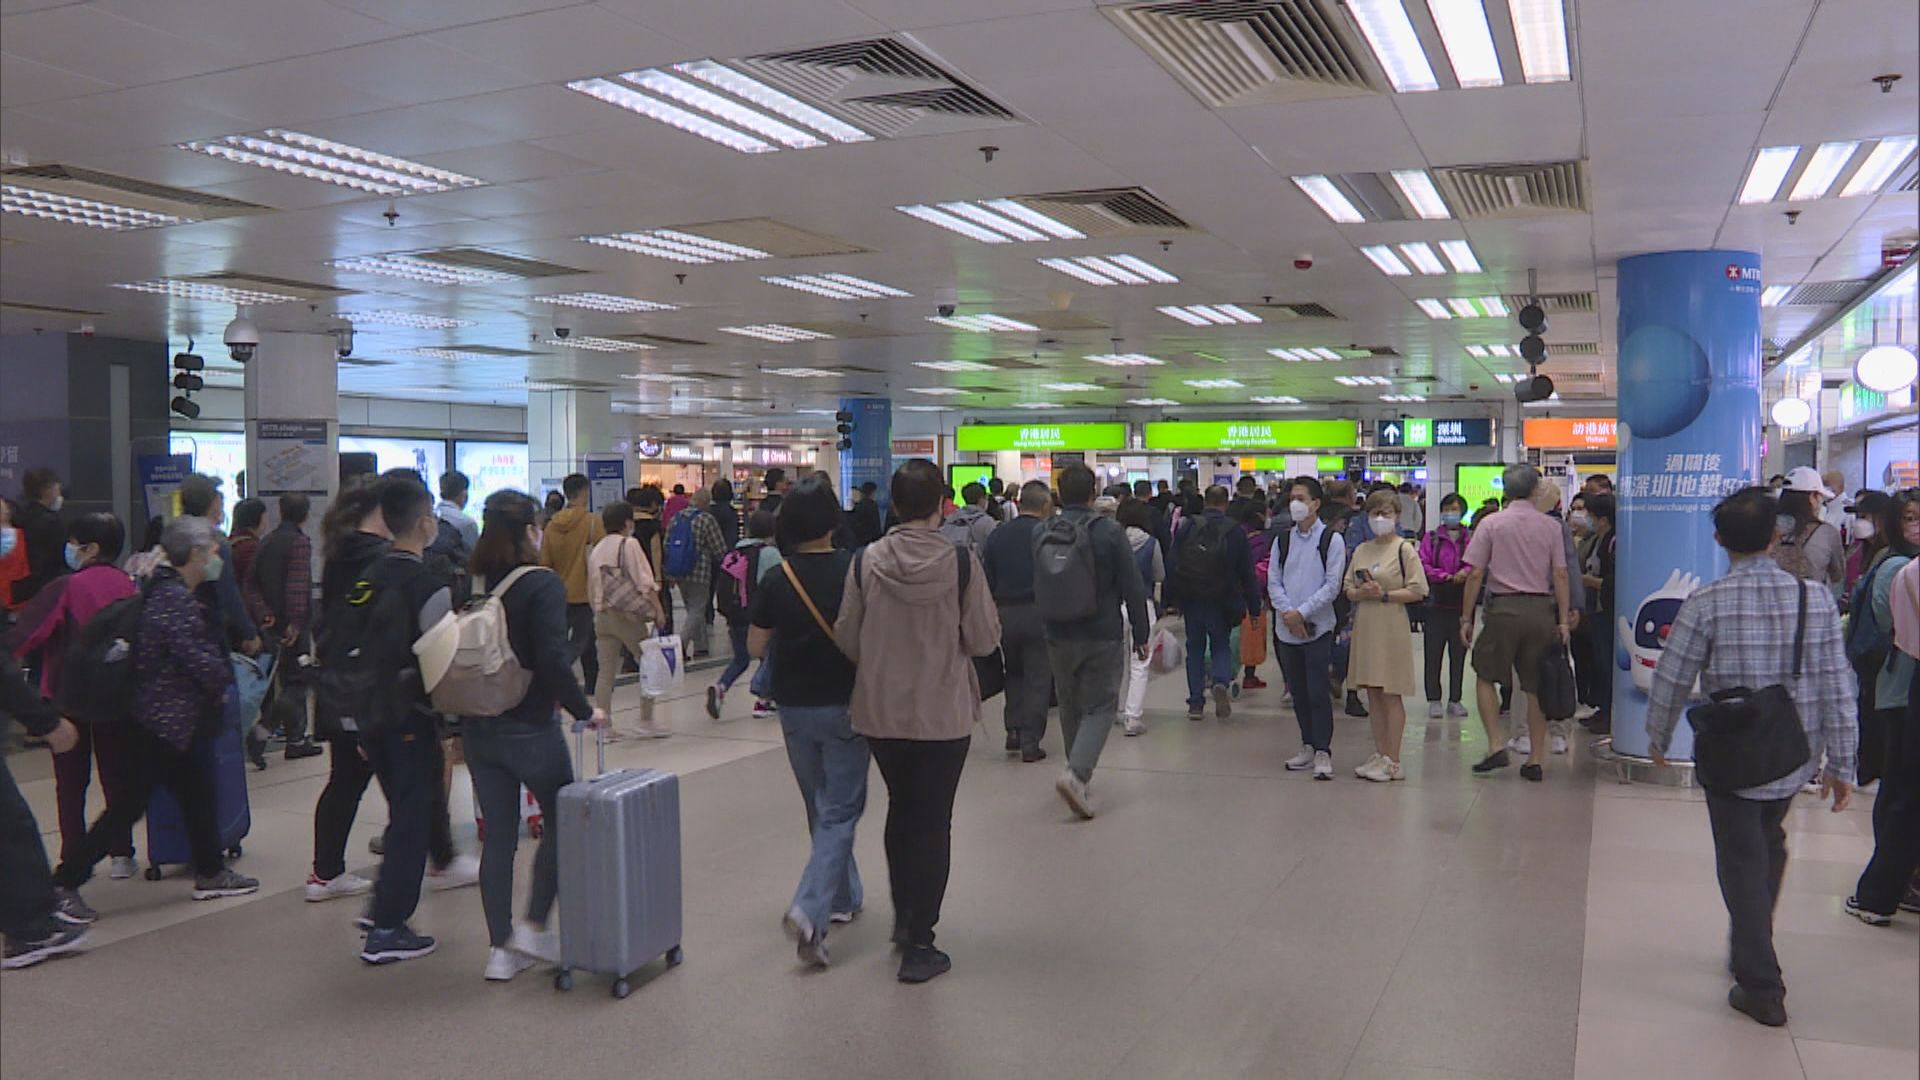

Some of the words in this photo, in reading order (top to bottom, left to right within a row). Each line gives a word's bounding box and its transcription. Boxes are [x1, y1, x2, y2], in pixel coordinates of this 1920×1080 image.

[1019, 427, 1061, 440] 香港居民
[1227, 425, 1272, 438] 香港居民
[1437, 421, 1463, 436] 深圳
[1220, 438, 1235, 447] Hong
[1235, 438, 1251, 447] Kong
[1251, 438, 1277, 446] Residents
[1436, 436, 1467, 444] Shenzhen
[1585, 436, 1608, 444] Visitors
[1664, 453, 1721, 472] 過關後
[1647, 502, 1698, 513] interchange
[1700, 503, 1711, 512] to
